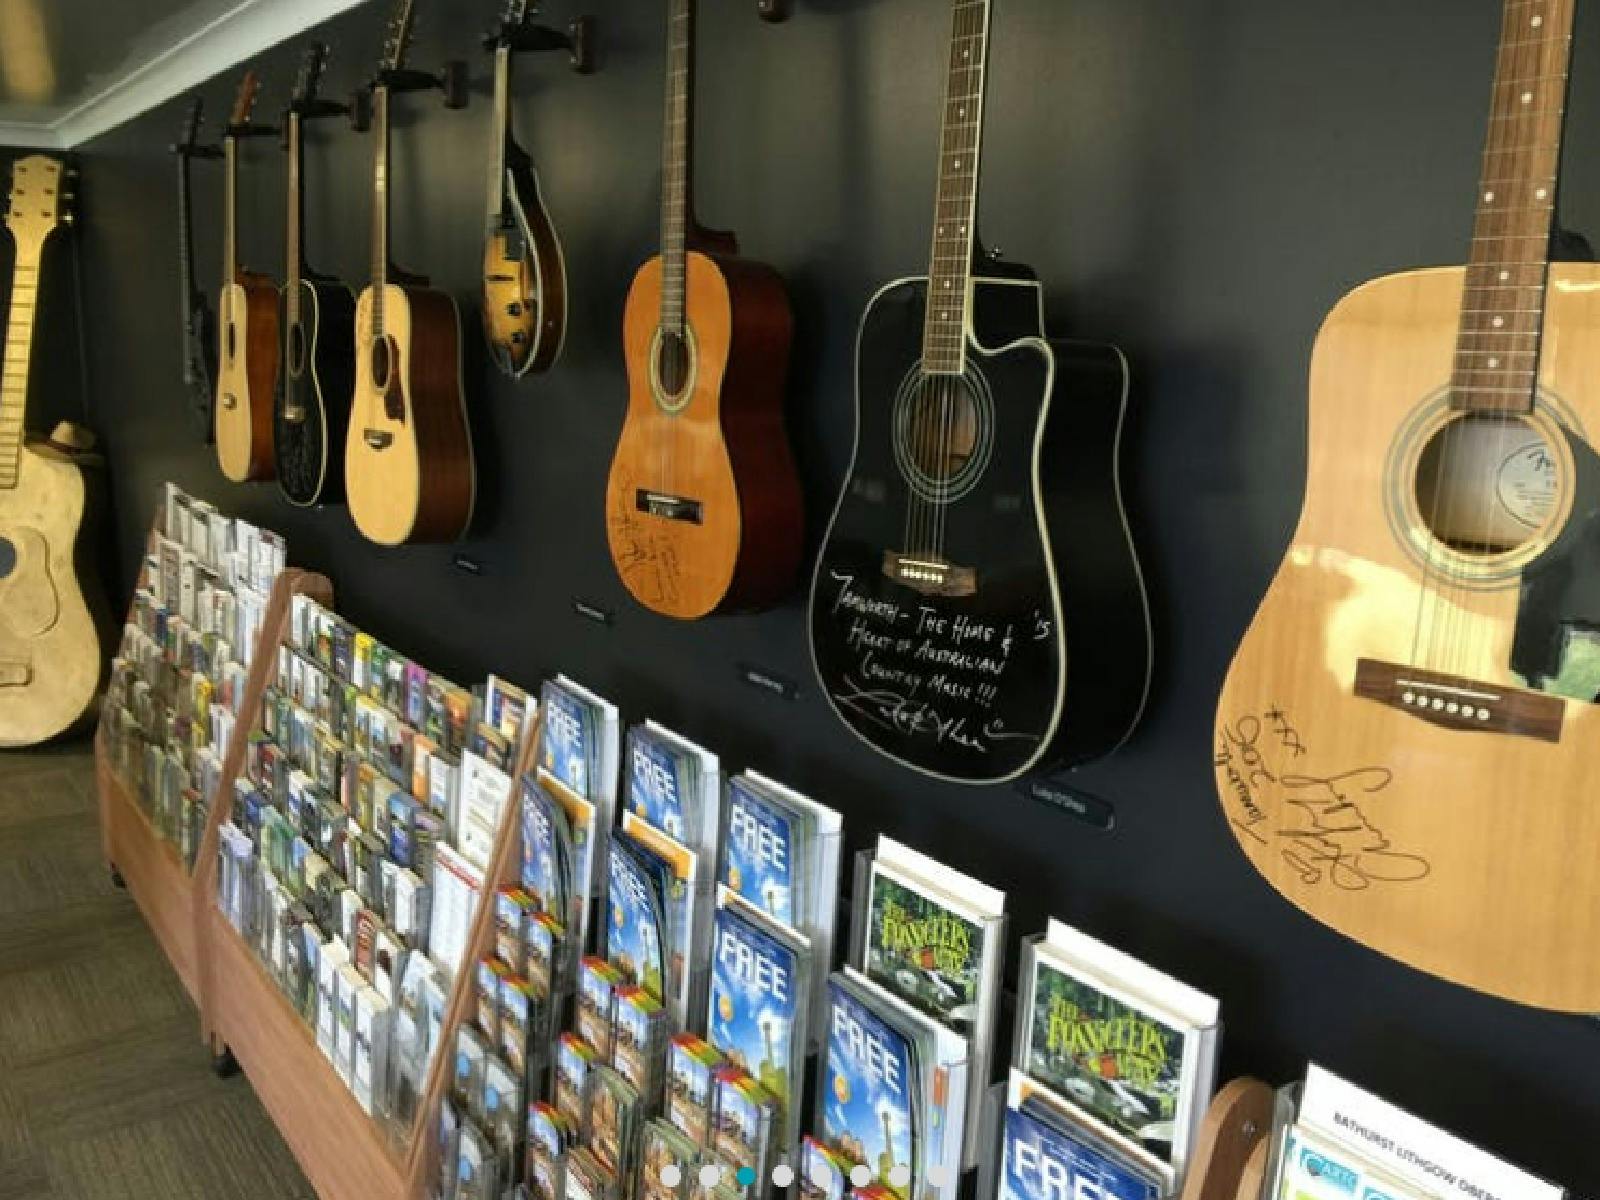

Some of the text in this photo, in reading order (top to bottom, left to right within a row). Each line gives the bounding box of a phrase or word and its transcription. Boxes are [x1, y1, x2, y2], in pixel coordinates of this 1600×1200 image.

[731, 803, 788, 873] FREE
[719, 929, 789, 1005] FREE
[833, 1000, 902, 1095] FREE
[1014, 1137, 1120, 1200] FRE
[1333, 1111, 1395, 1151] BATHURST
[1396, 1147, 1457, 1185] LITHGOW
